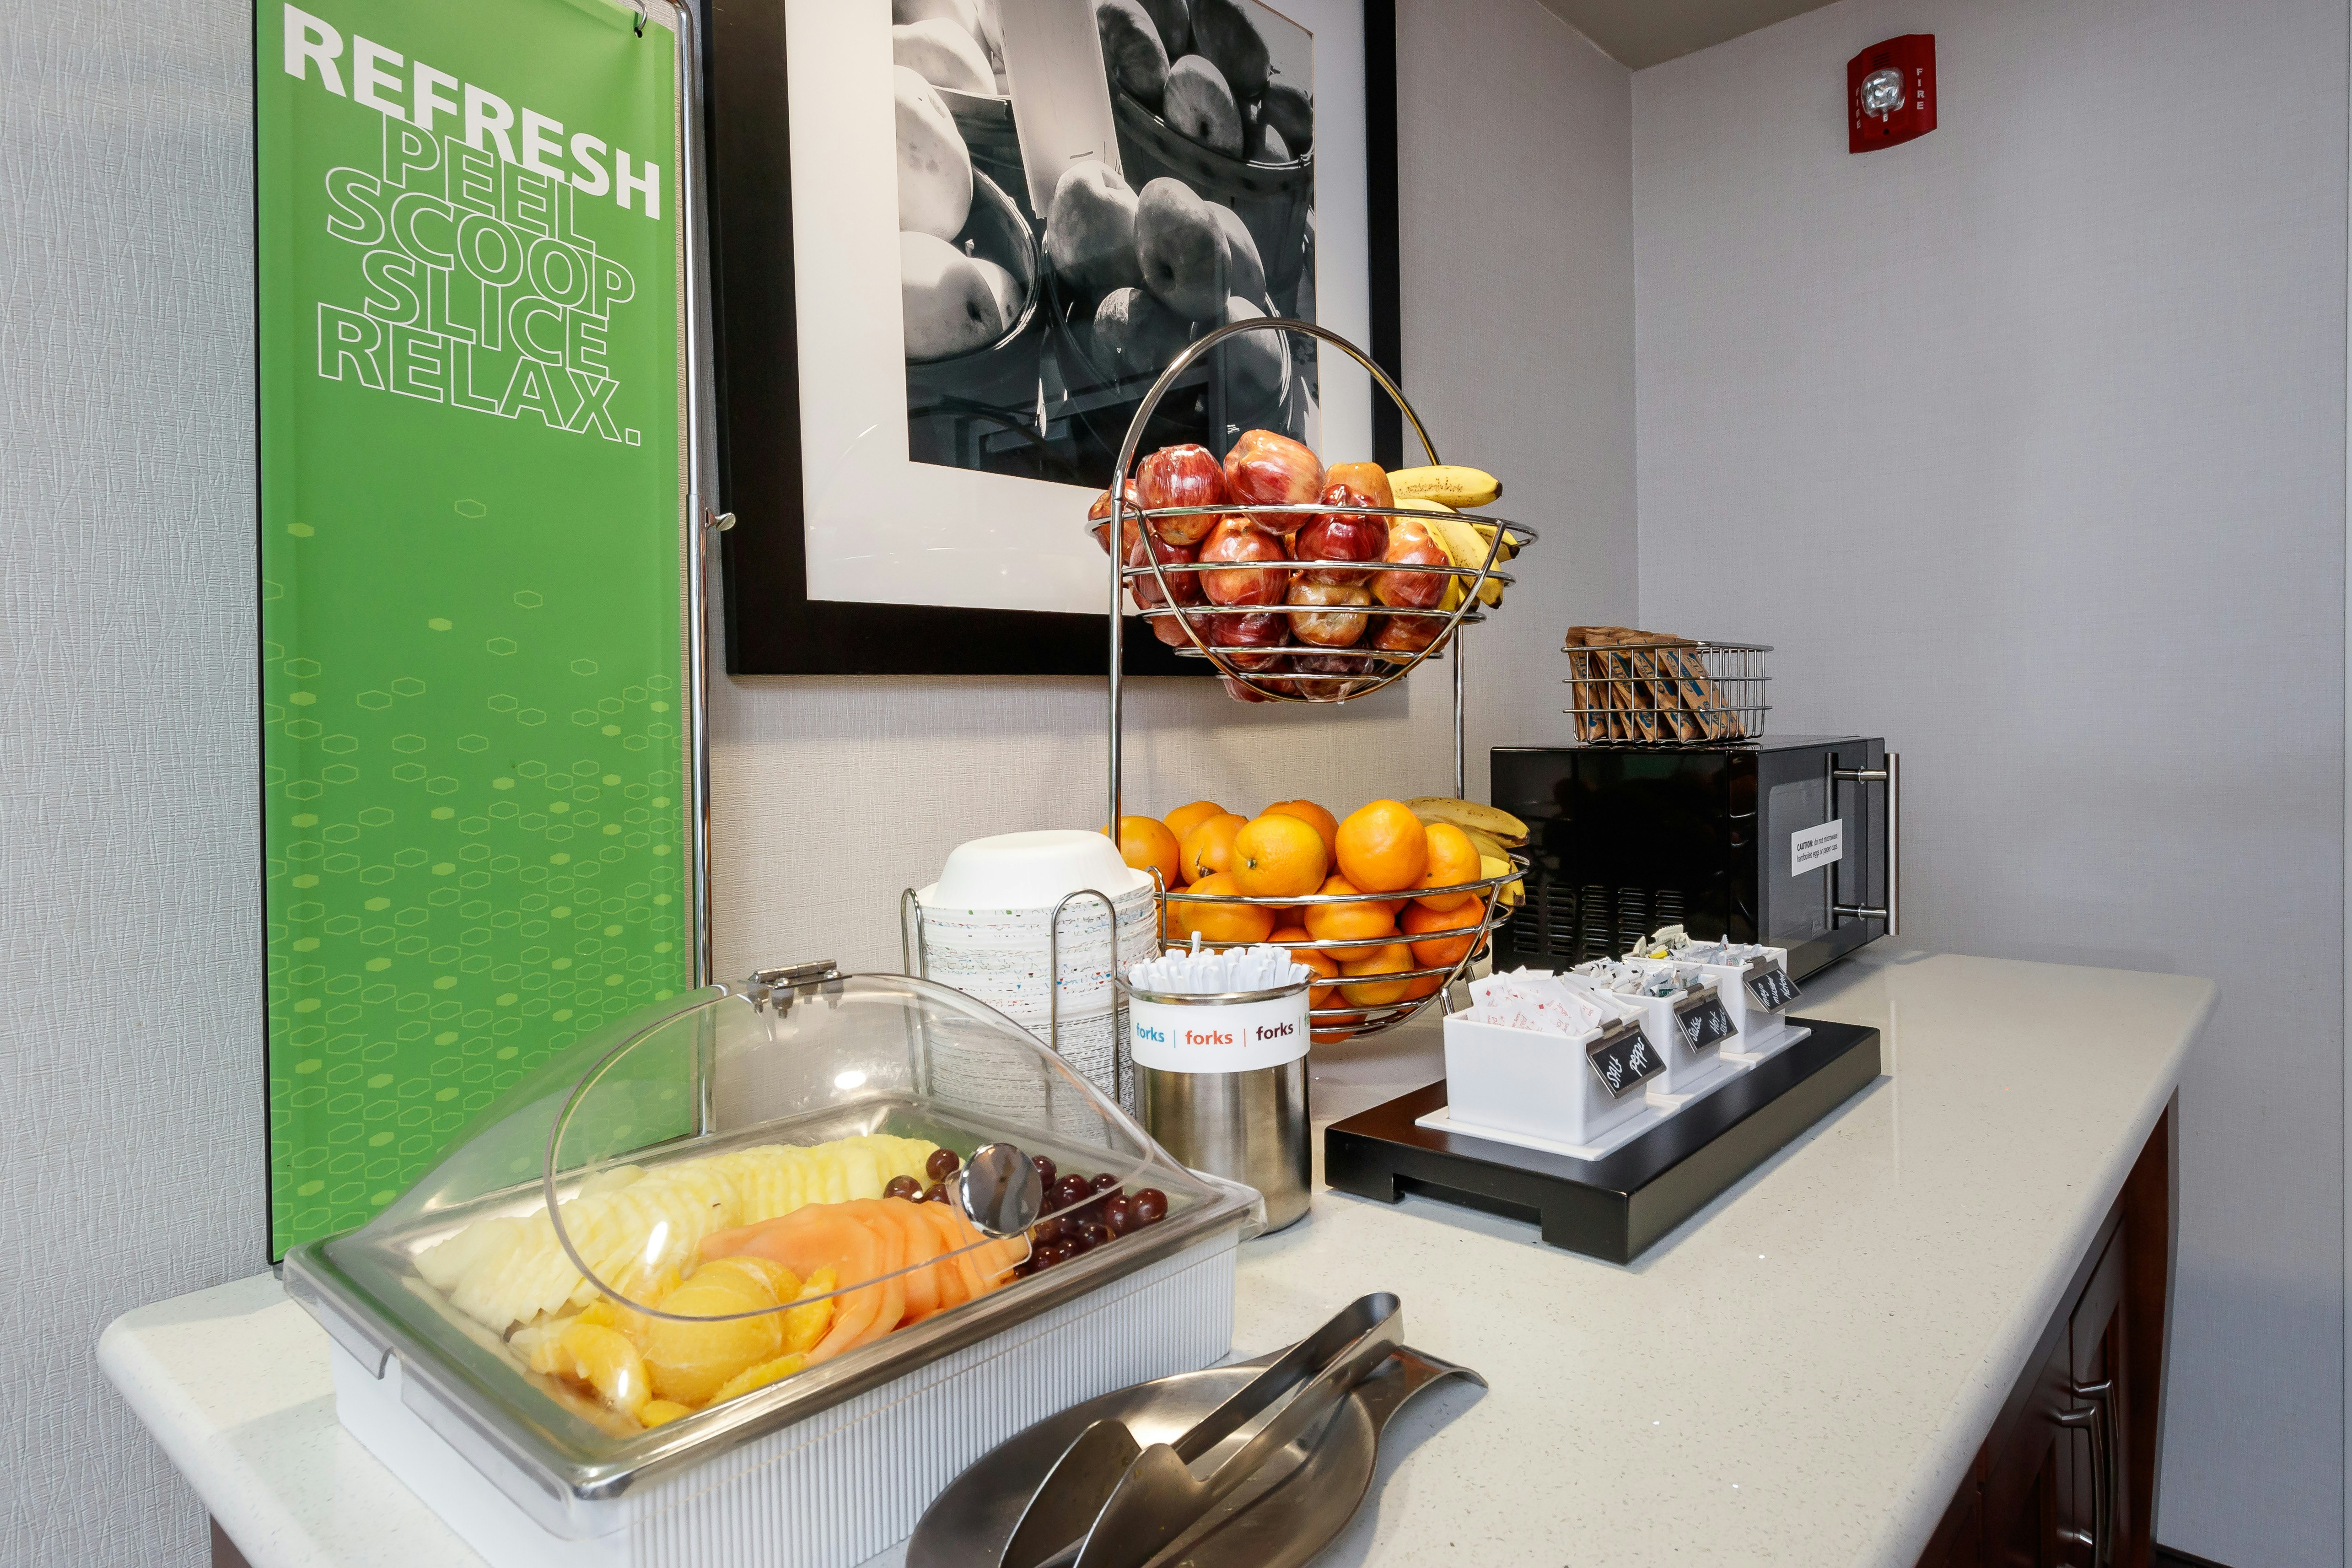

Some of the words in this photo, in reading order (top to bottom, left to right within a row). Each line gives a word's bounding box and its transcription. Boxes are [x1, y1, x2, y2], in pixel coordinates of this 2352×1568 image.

[284, 2, 660, 220] REFRESH
[1916, 68, 1925, 110] FIRE
[325, 166, 635, 320] SCOOP
[382, 111, 596, 255] PEEL
[318, 302, 641, 447] RELAX.
[363, 249, 609, 380] SLICE
[1797, 840, 1813, 851] CAUTION:
[1814, 838, 1818, 846] do
[1136, 1022, 1165, 1043] forks
[1185, 1030, 1233, 1045] forks
[1255, 1022, 1294, 1041] forks
